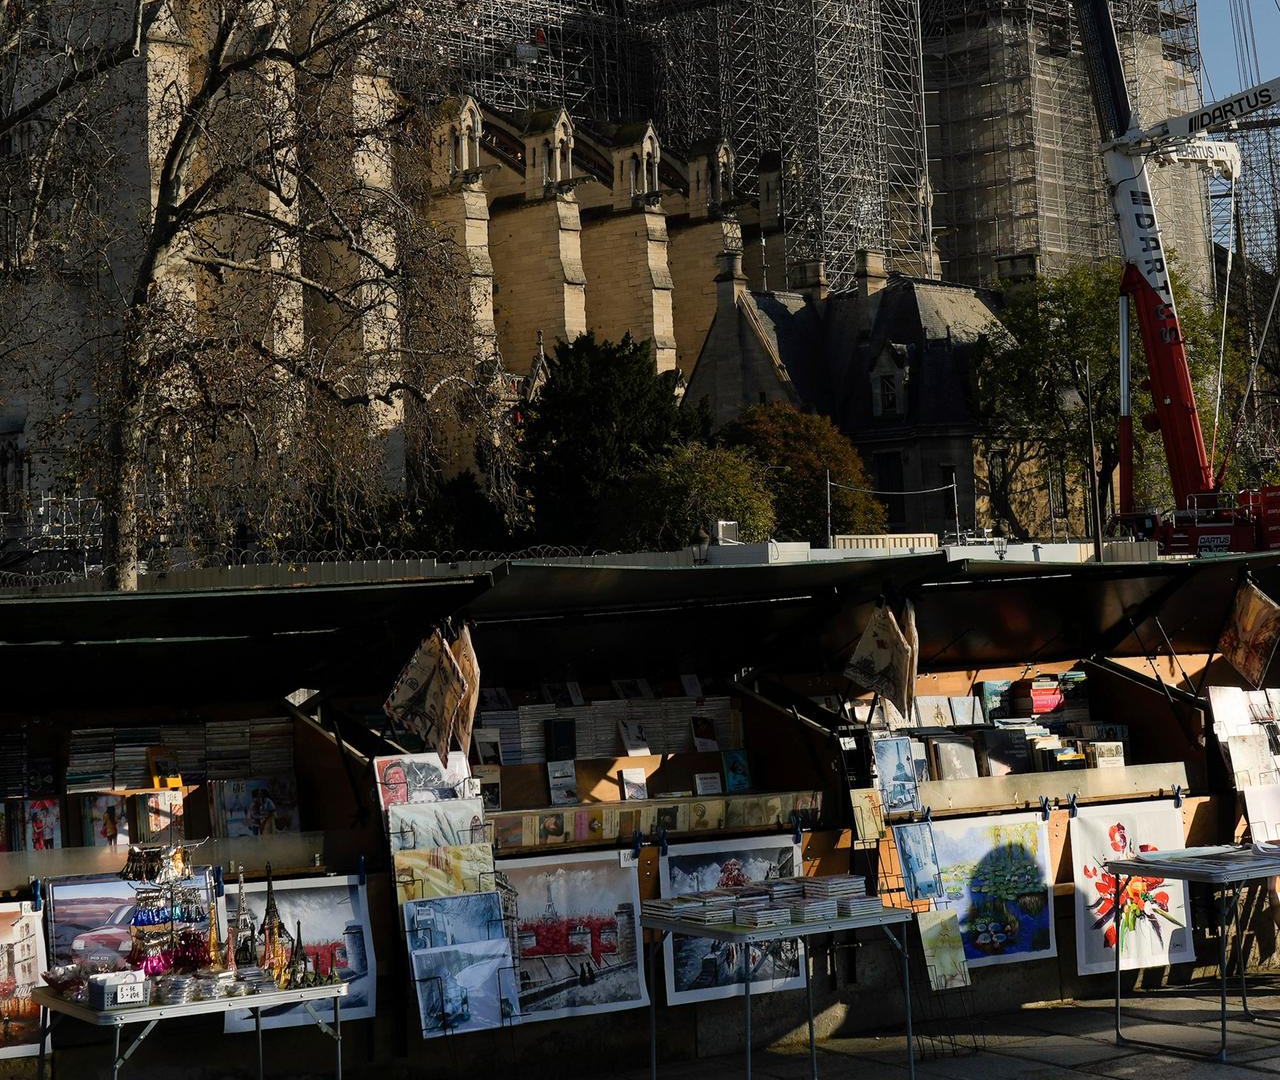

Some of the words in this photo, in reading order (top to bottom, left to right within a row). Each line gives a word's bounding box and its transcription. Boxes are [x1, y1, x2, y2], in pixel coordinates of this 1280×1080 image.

[1199, 88, 1272, 128] DARTUS
[1135, 213, 1181, 344] DARTUS
[1199, 536, 1230, 544] DARTUS
